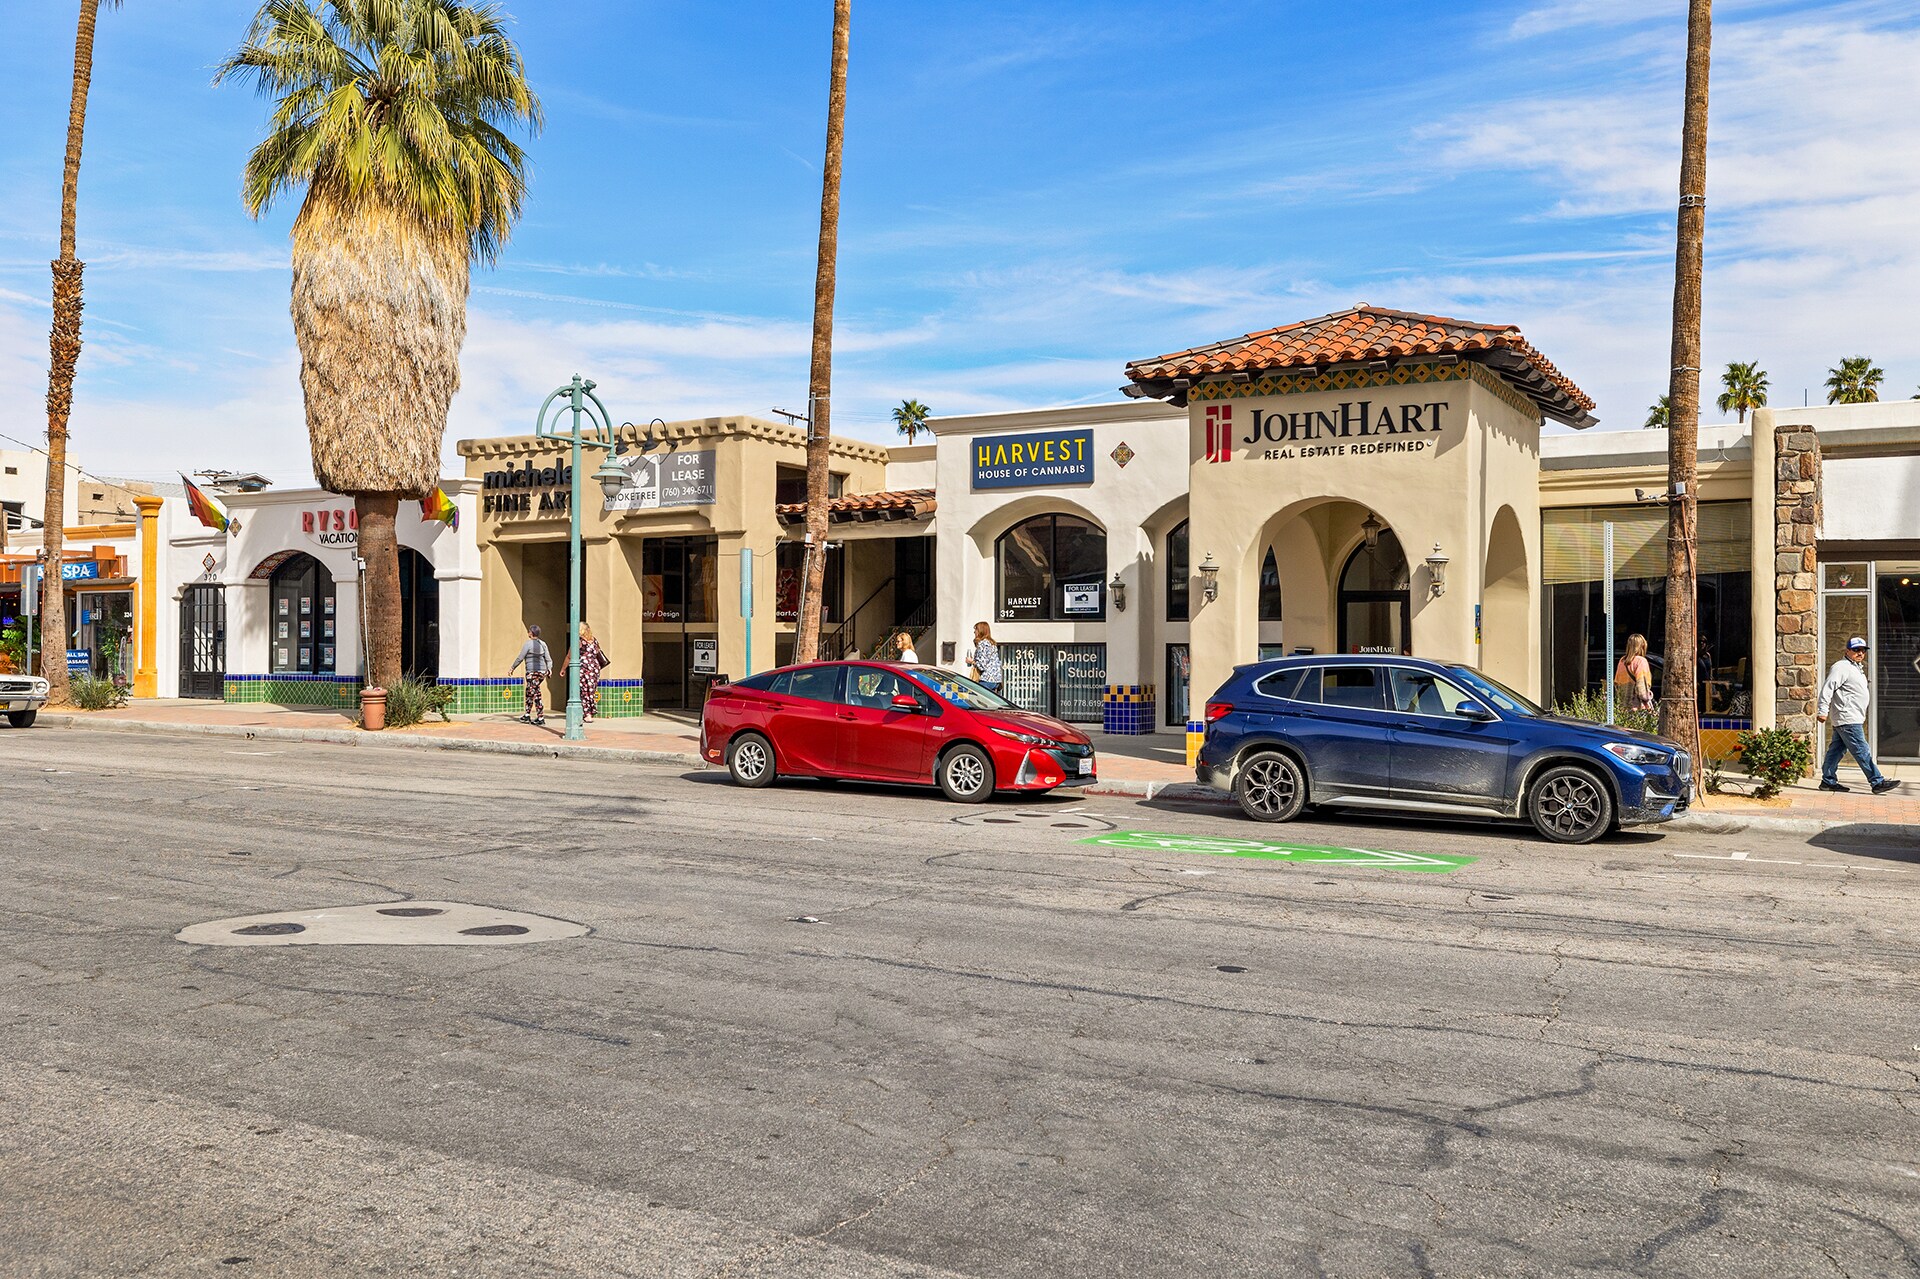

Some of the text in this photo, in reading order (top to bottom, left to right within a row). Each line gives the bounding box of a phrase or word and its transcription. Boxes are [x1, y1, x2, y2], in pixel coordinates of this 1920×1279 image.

[978, 438, 1086, 468] HARVEST
[1264, 440, 1425, 461] REAL ESTATE REDEFINED
[677, 454, 700, 466] FOR
[484, 457, 572, 490] michele
[671, 469, 705, 482] LEASE
[978, 464, 1086, 480] HOUSE OF CANNABIS
[661, 486, 680, 499] (760)
[484, 493, 531, 513] FINE
[63, 565, 91, 579] SPA
[203, 573, 218, 582] 320
[1007, 597, 1042, 606] HARVEST
[657, 610, 680, 618] Design
[1000, 609, 1015, 618] 312
[1015, 649, 1035, 660] 316
[1058, 650, 1097, 662] Dance
[1067, 667, 1106, 678] Studio
